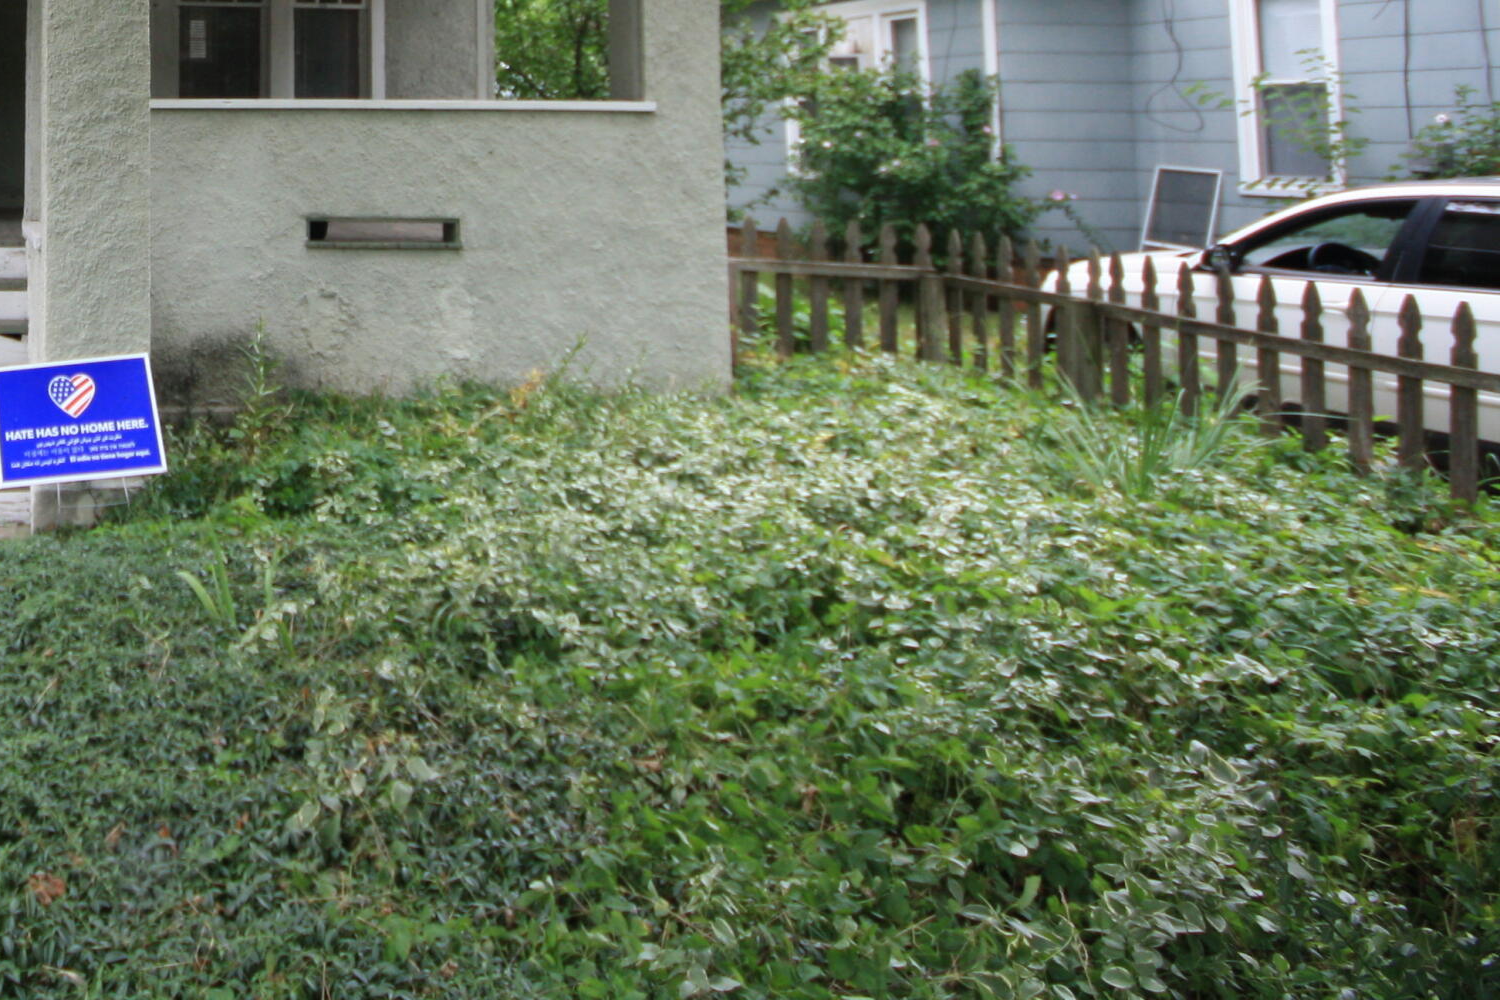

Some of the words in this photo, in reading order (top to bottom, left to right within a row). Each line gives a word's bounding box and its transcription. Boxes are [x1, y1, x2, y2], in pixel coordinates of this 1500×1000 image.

[5, 428, 34, 441] HATE
[36, 426, 59, 438] HAS
[60, 424, 78, 436] NO
[80, 421, 115, 434] HOME
[116, 418, 148, 431] HERE.
